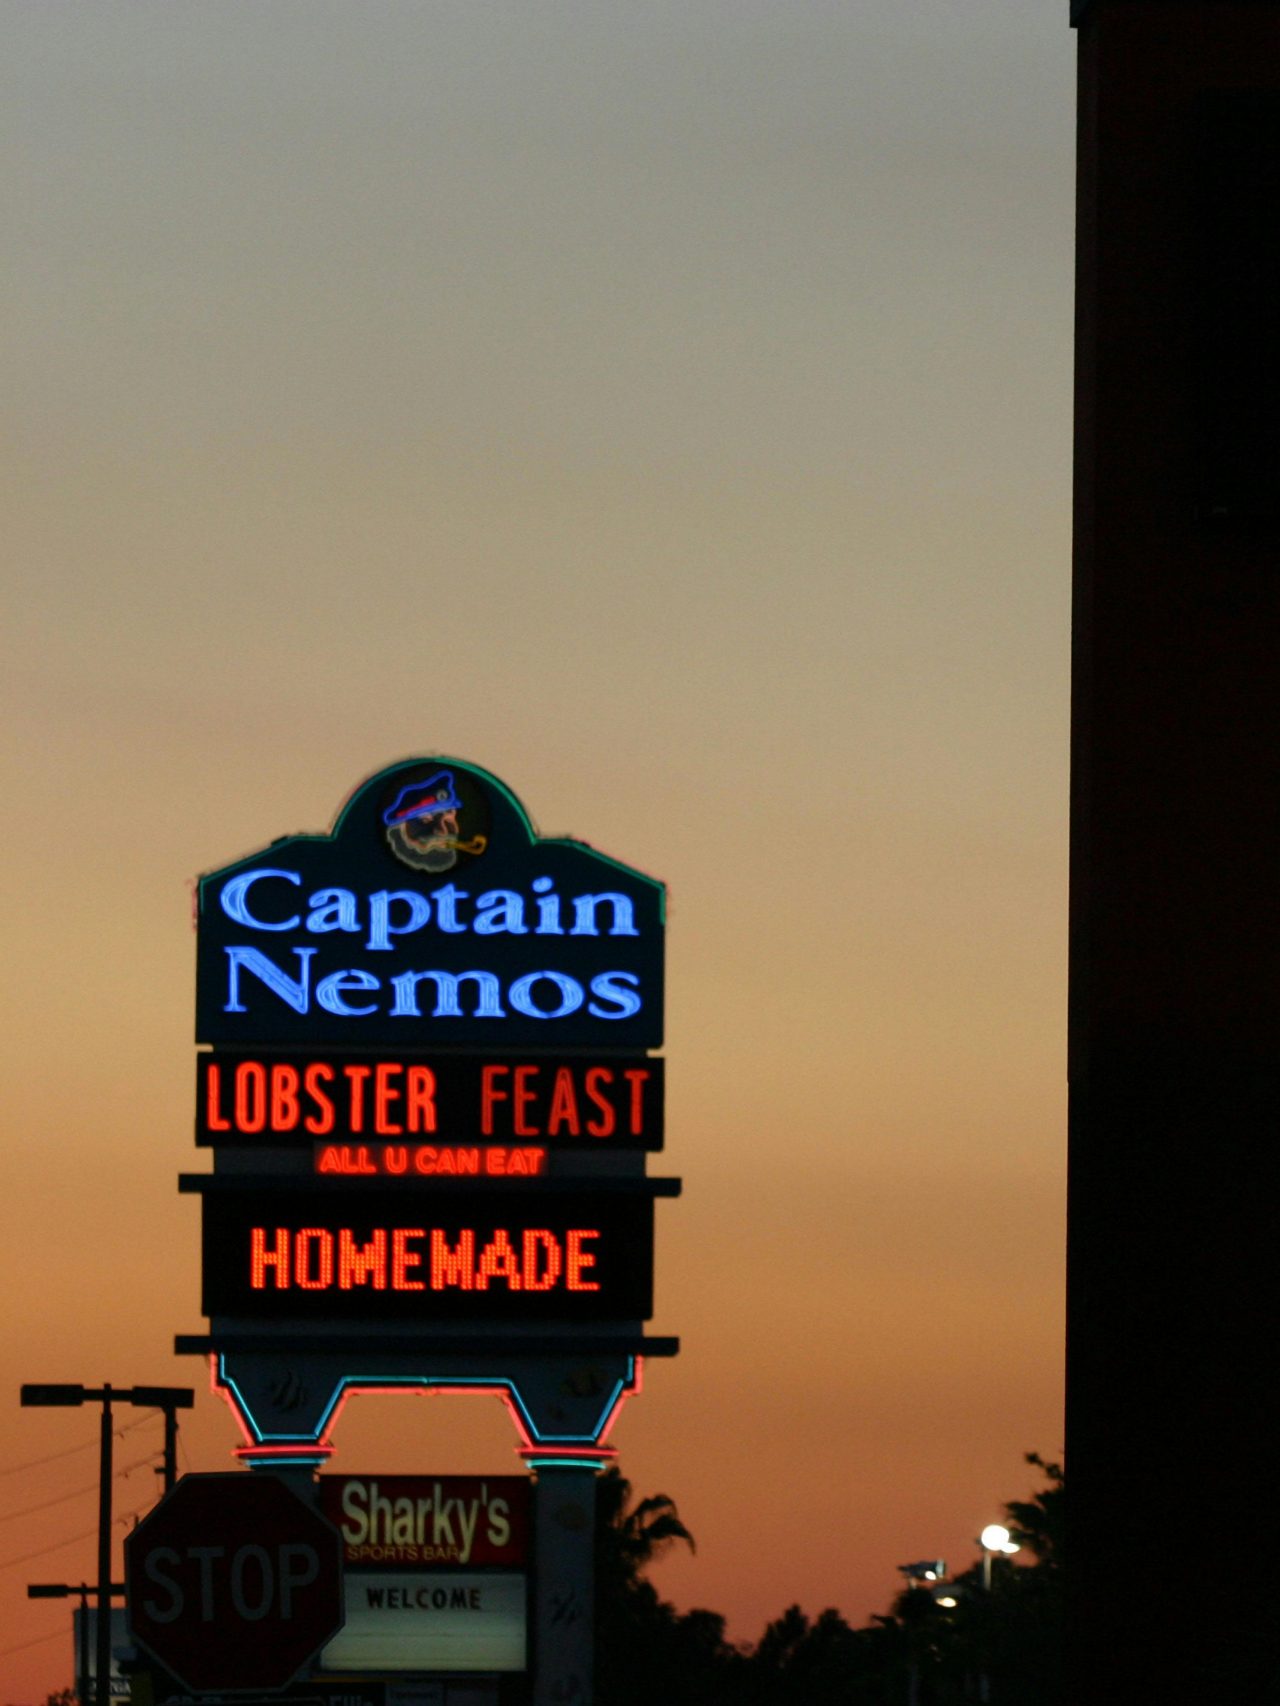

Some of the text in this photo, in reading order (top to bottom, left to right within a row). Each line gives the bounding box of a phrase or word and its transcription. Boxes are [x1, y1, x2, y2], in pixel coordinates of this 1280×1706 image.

[219, 867, 640, 951] Captain
[222, 945, 643, 1020] Nemos
[205, 1060, 651, 1138] LOBSTER FEAST
[319, 1145, 544, 1175] ALL U CAN EAT
[248, 1226, 603, 1292] HOMEMADE
[341, 1480, 512, 1565] Sharky's
[347, 1545, 459, 1561] SPORTS BAR
[143, 1543, 321, 1624] STOP
[367, 1588, 482, 1610] WELCOME
